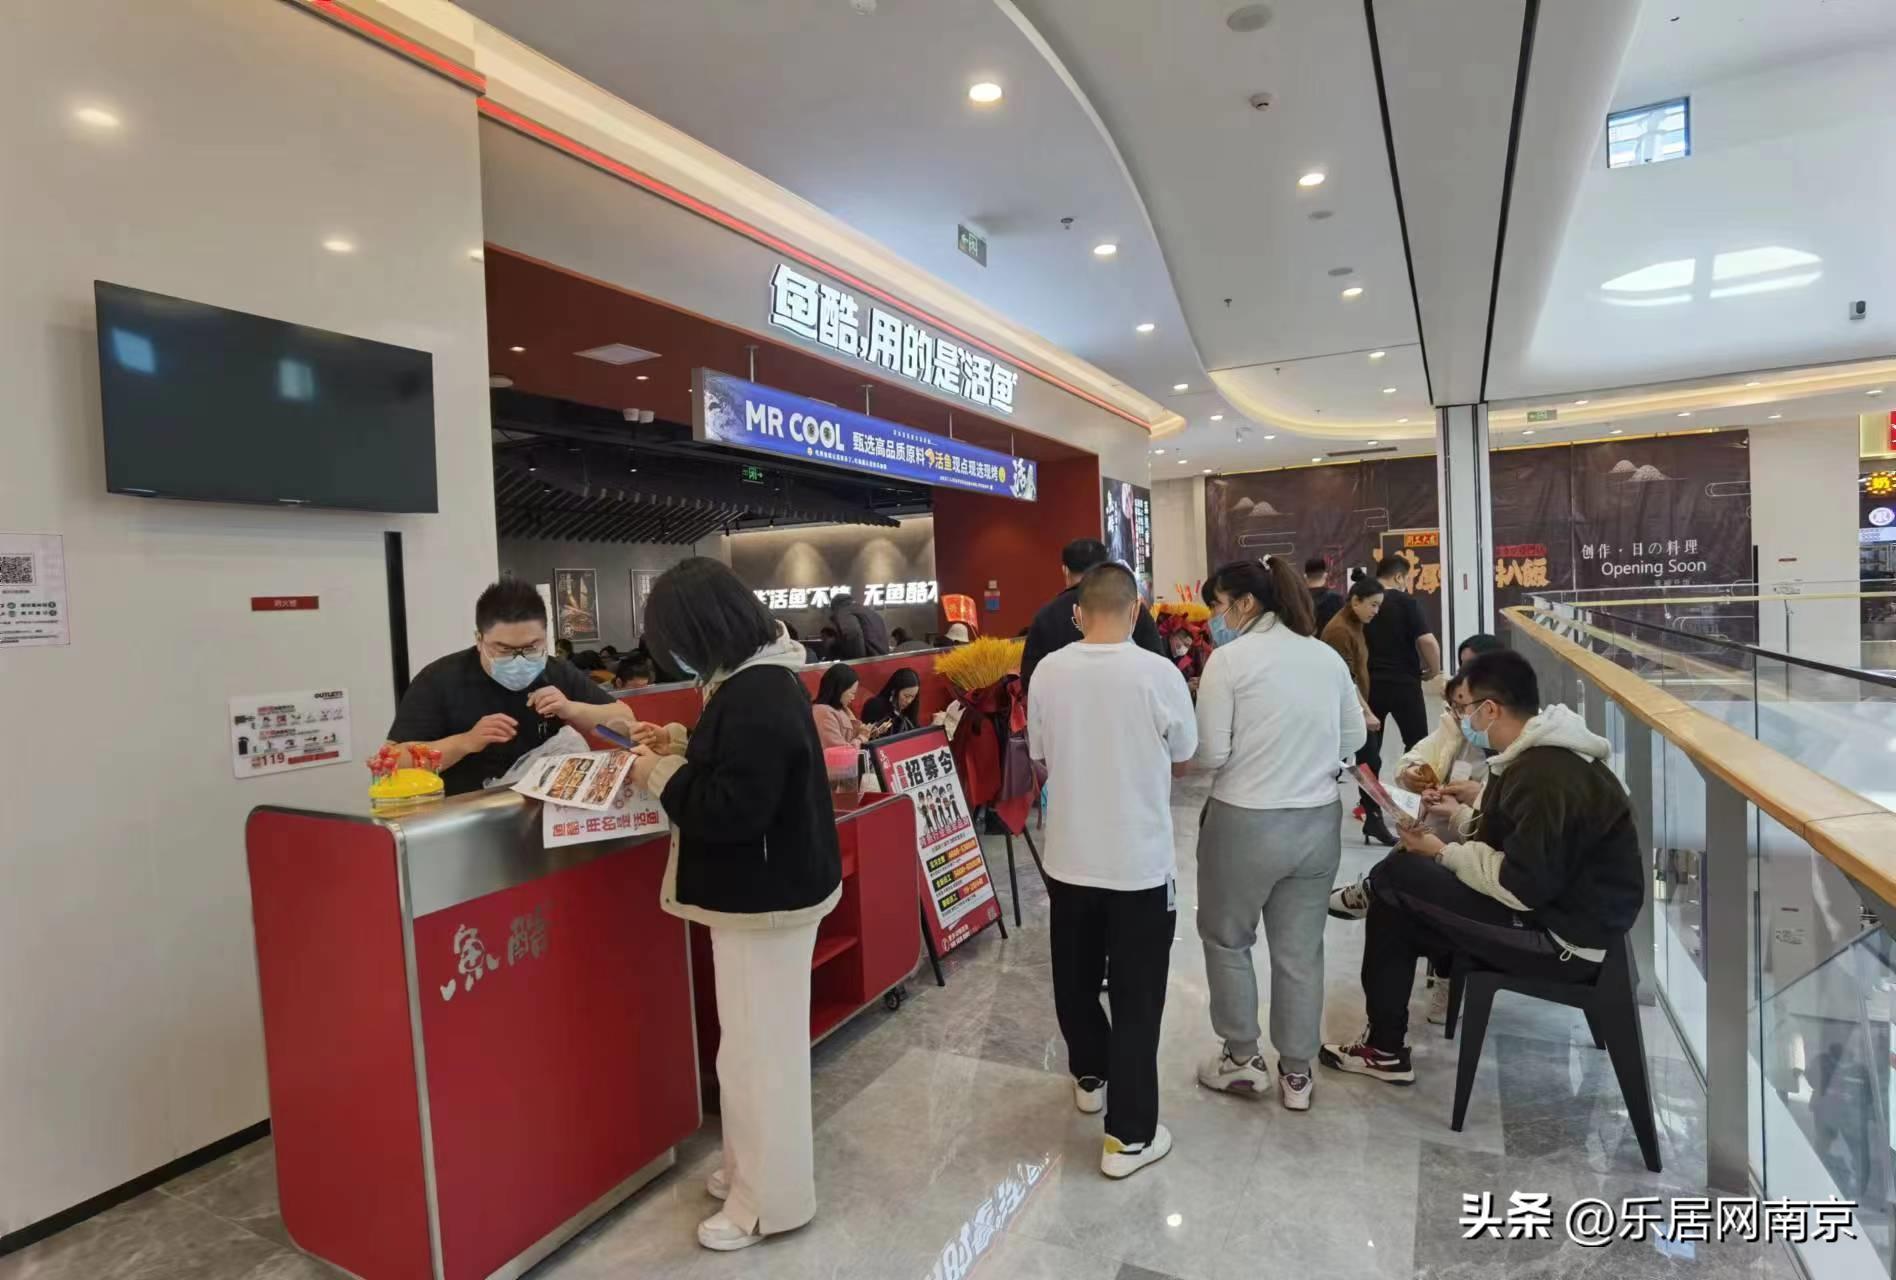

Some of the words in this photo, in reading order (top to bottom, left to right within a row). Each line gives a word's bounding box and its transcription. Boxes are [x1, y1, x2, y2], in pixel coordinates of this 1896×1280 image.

[745, 400, 784, 438] MR
[789, 413, 845, 451] COOL
[1601, 560, 1663, 578] Opening
[1668, 558, 1707, 573] Soon
[262, 752, 285, 766] 119
[904, 750, 953, 787] 招募令
